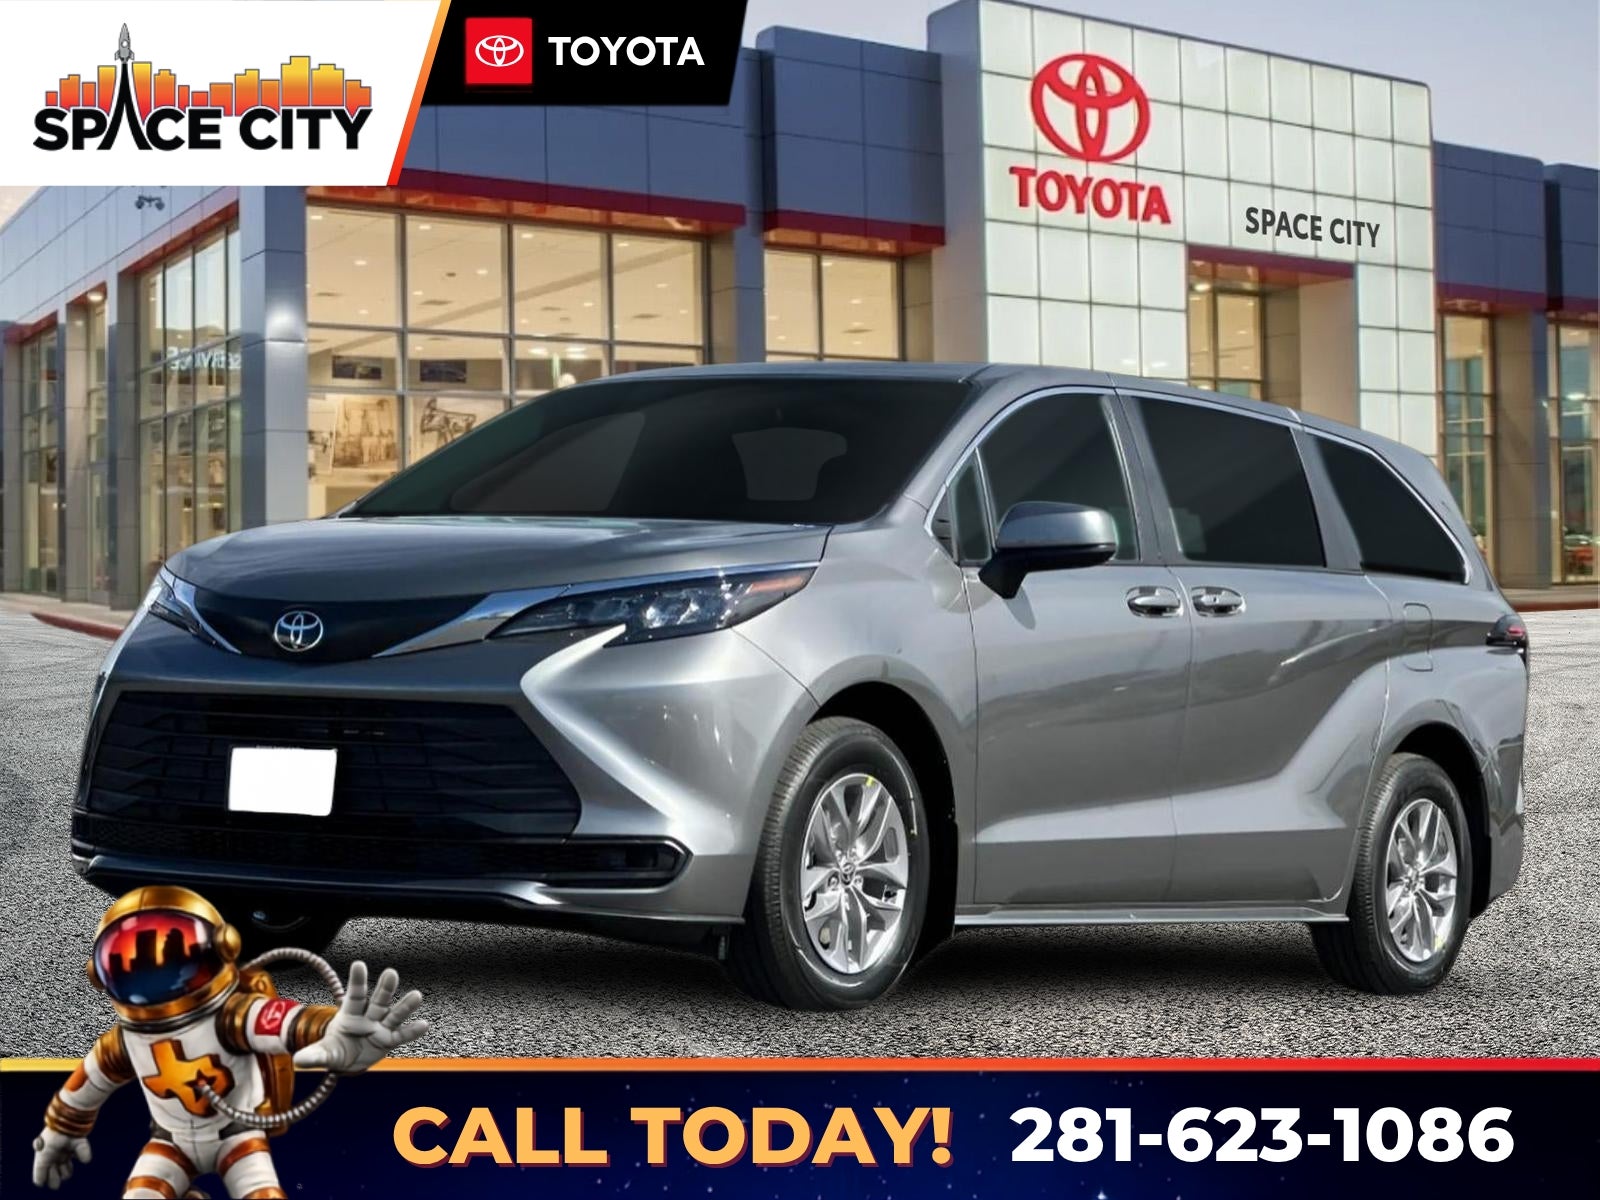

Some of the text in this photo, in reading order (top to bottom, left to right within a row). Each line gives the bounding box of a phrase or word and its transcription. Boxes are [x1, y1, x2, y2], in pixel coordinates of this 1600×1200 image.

[1010, 166, 1171, 224] TOYOTA
[1245, 206, 1381, 248] SPACE CITY
